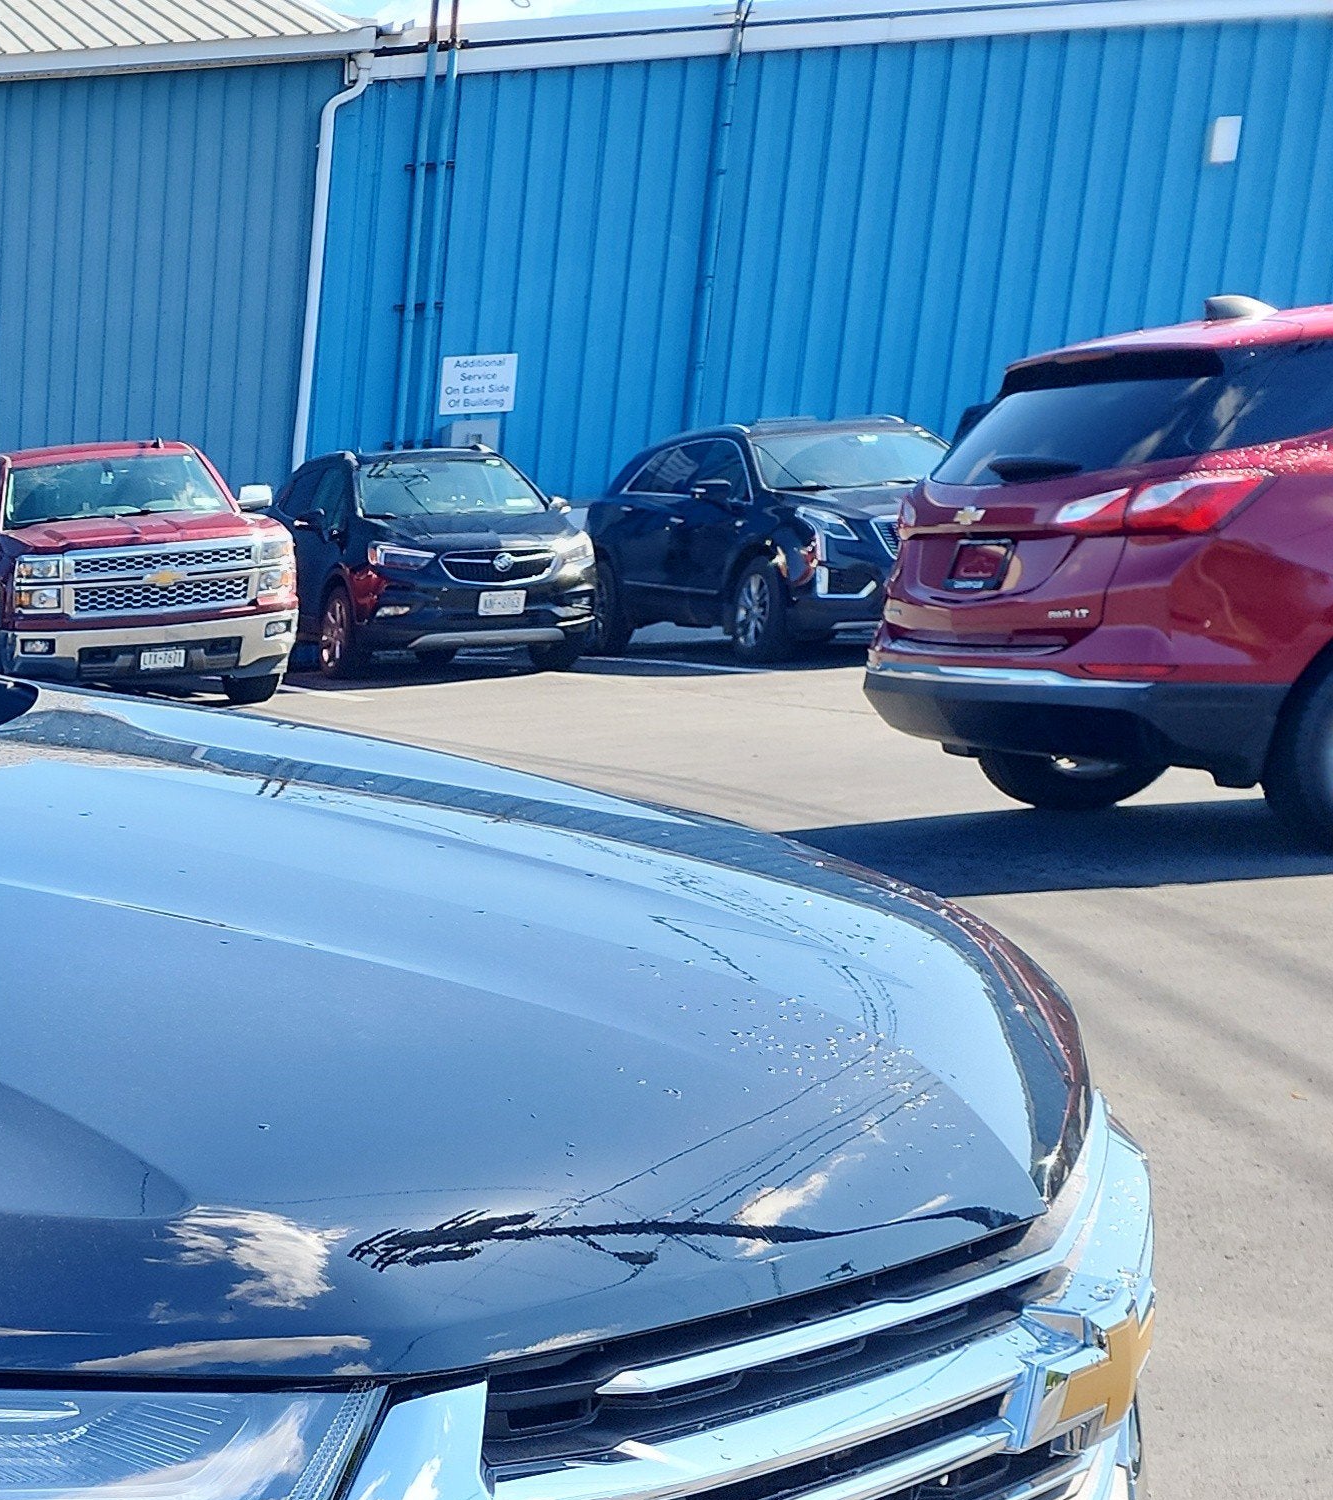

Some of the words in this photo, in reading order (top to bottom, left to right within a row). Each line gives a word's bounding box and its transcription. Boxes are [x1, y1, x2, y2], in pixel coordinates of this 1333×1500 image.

[454, 358, 506, 369] Additional
[460, 372, 497, 381] Service
[445, 386, 459, 395] On
[463, 385, 485, 394] East
[488, 384, 510, 393] Side
[448, 399, 460, 407] Of
[463, 398, 504, 408] Building
